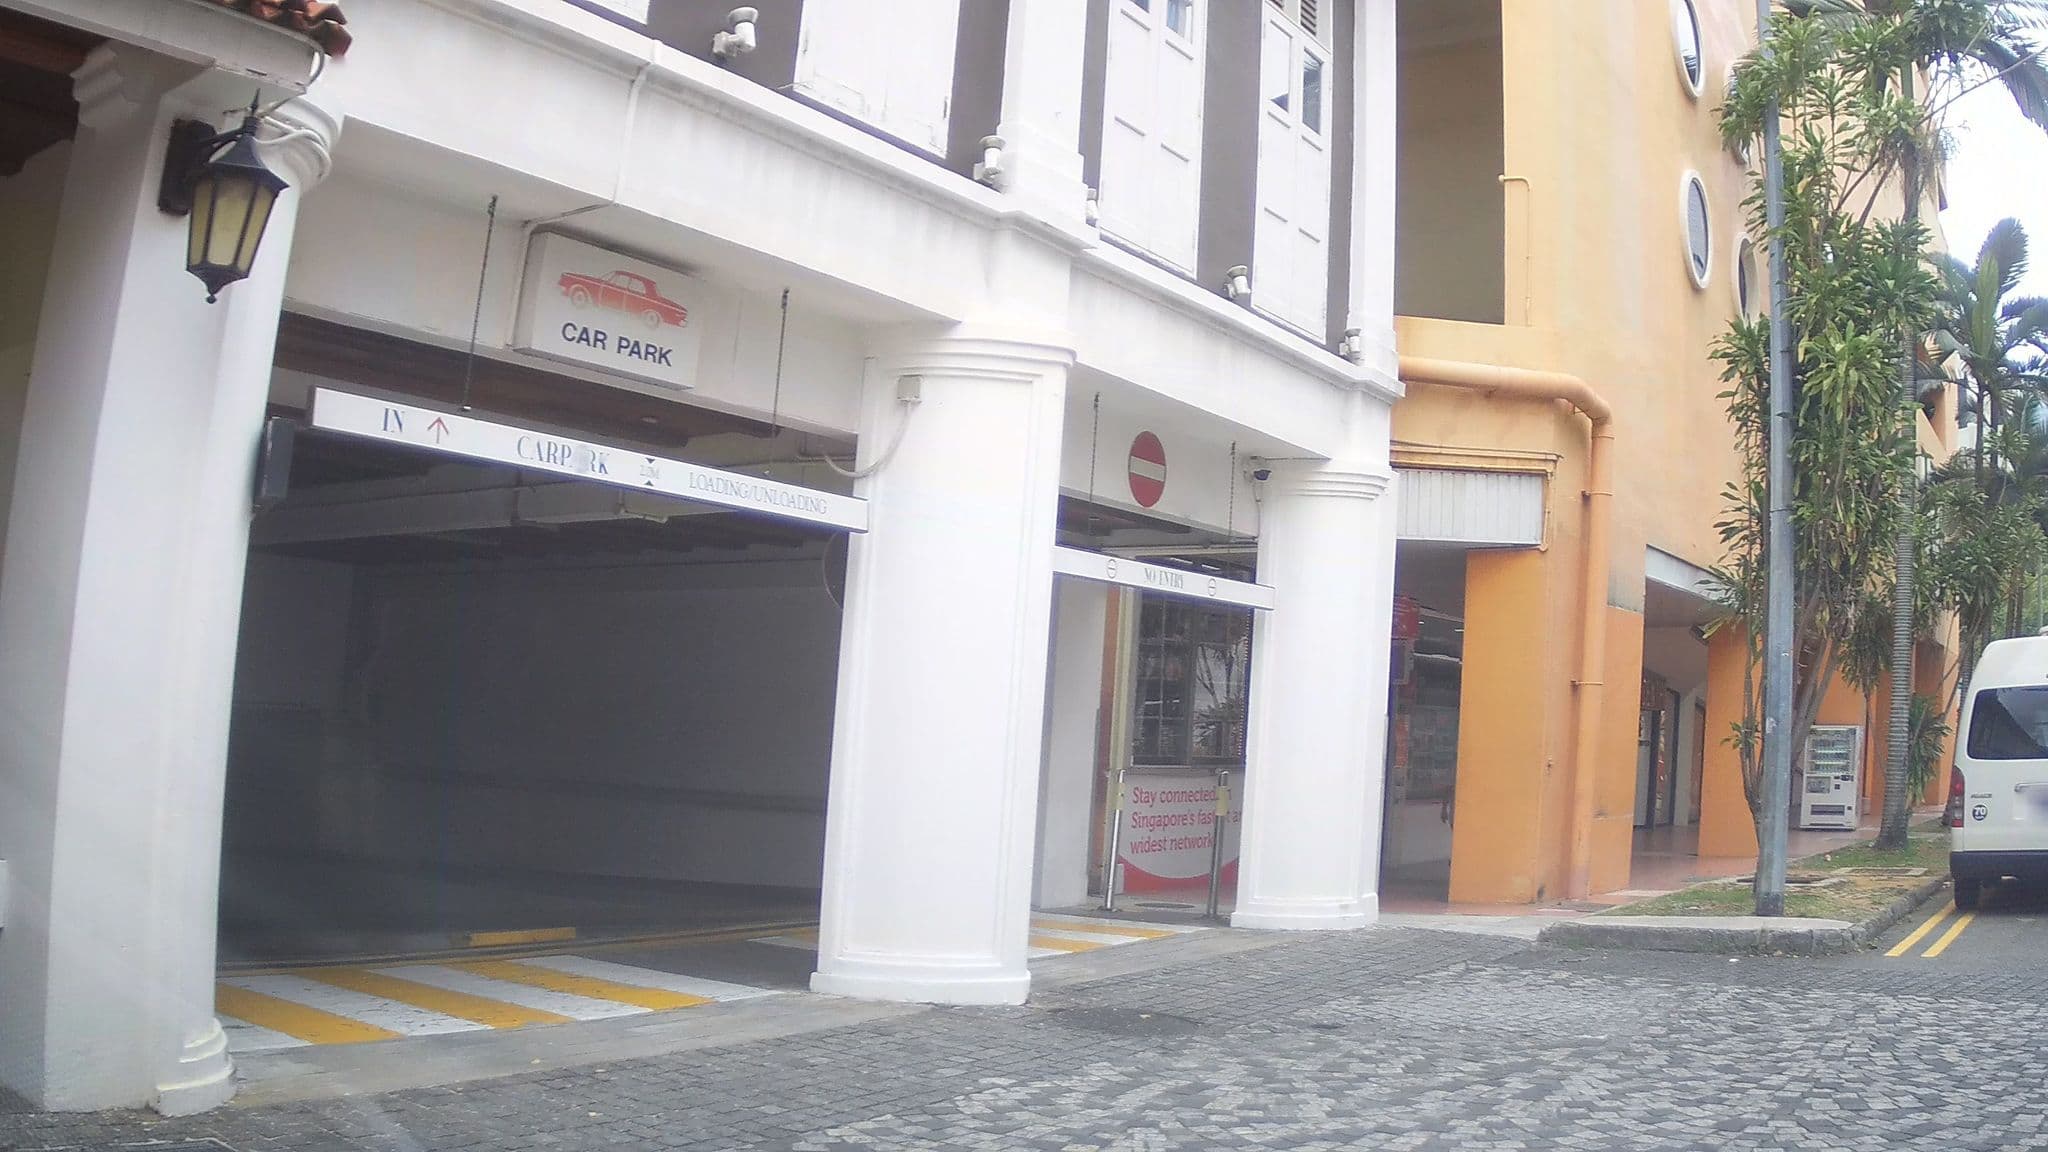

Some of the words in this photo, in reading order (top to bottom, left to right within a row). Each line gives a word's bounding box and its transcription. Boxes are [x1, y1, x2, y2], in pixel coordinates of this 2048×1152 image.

[561, 322, 608, 351] CAR
[616, 335, 673, 367] PARK
[382, 407, 405, 433] IN
[516, 435, 610, 475] CARPRK
[688, 472, 828, 515] LOADING/UNLOADING
[1143, 568, 1156, 583] NO
[1159, 570, 1184, 589] ENTRY
[1132, 786, 1158, 808] Stay
[1130, 810, 1194, 833] Singapore's
[1974, 807, 1986, 816] 70
[1130, 835, 1168, 855] widest
[1169, 831, 1216, 851] network
